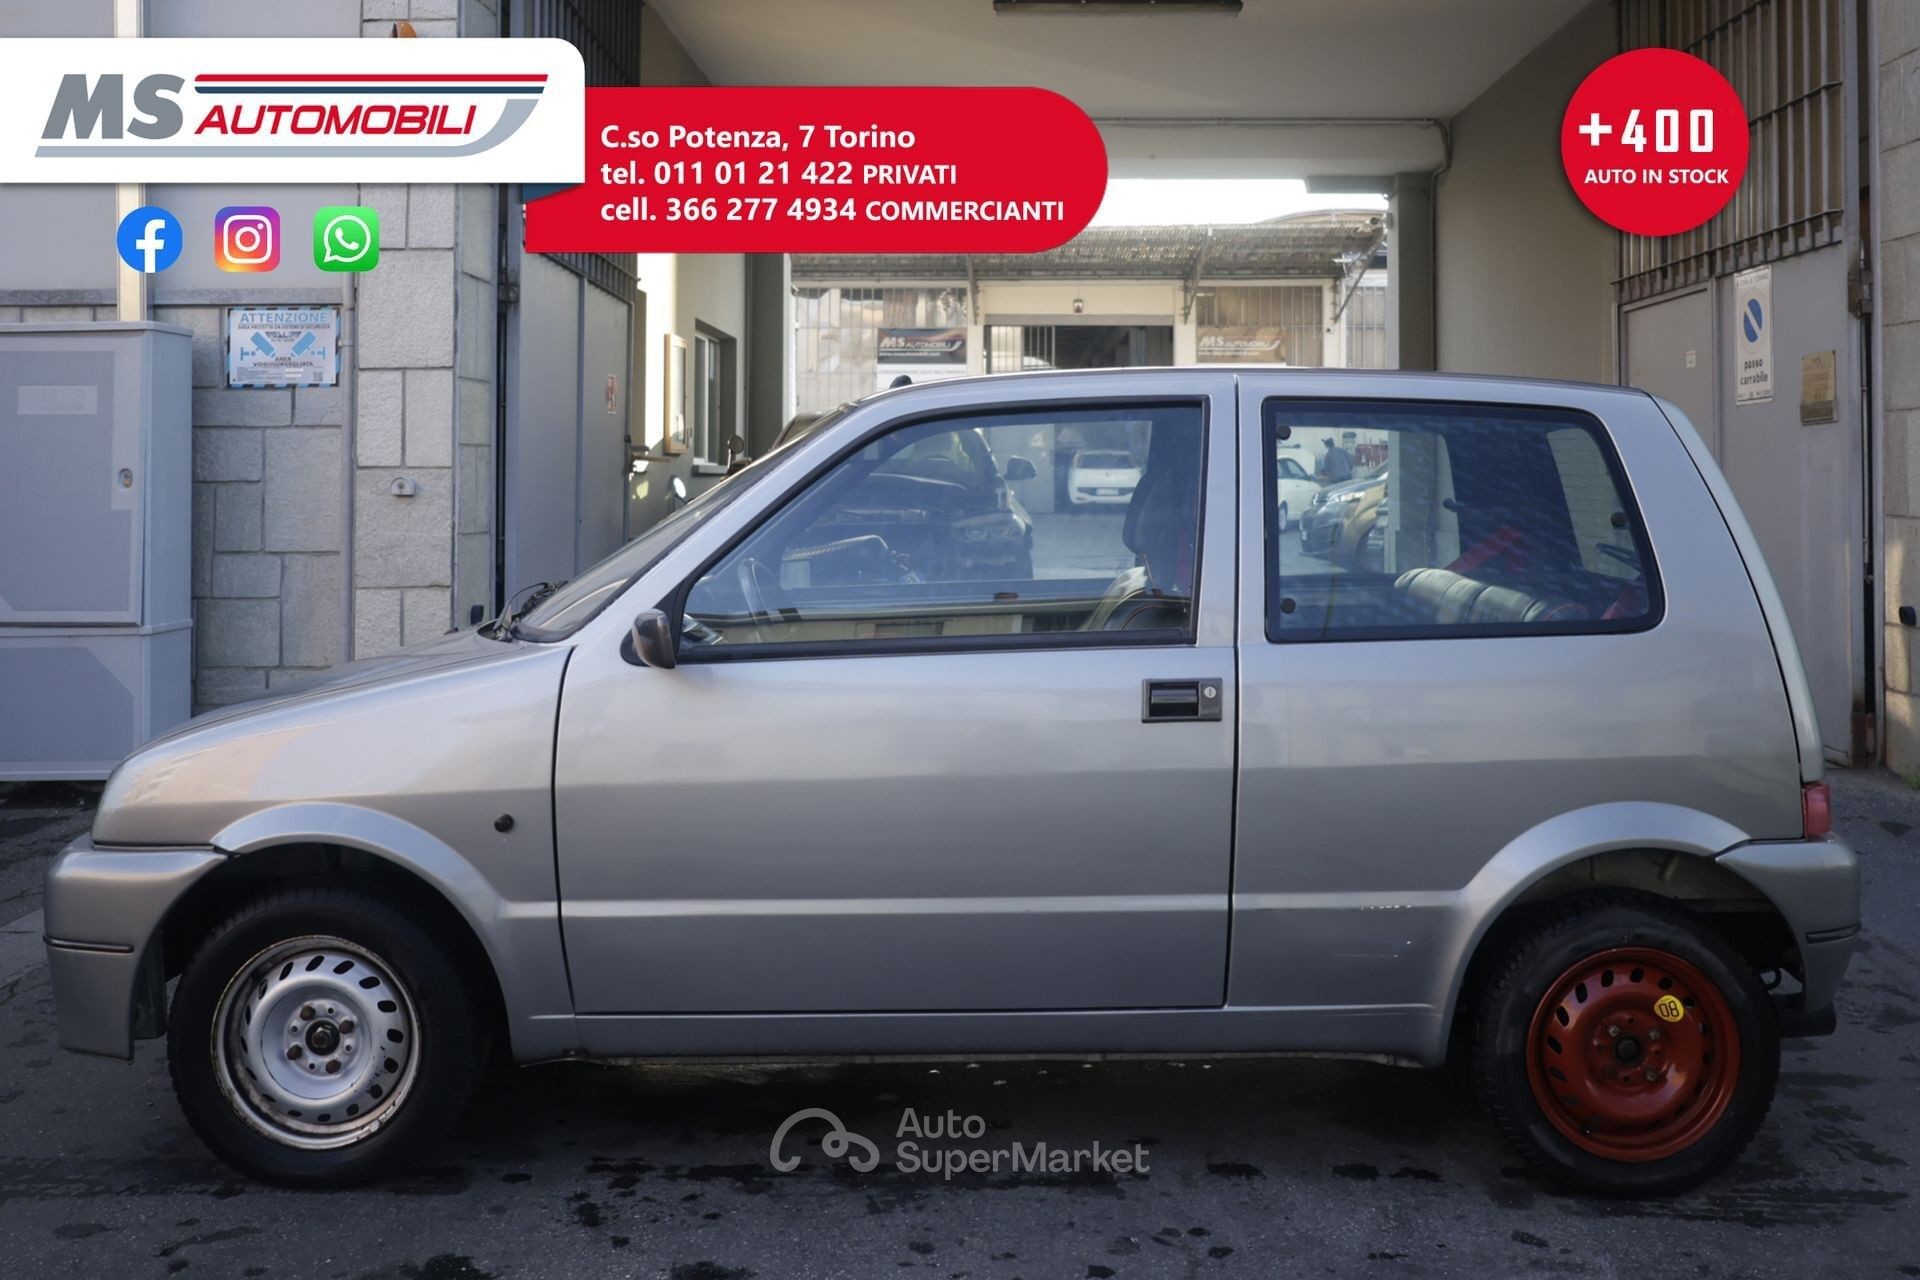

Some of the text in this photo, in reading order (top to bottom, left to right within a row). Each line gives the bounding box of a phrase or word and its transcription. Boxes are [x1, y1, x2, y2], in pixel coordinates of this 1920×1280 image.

[240, 312, 327, 323] ATTENZIONE
[880, 336, 905, 348] MS
[1744, 359, 1763, 372] passo
